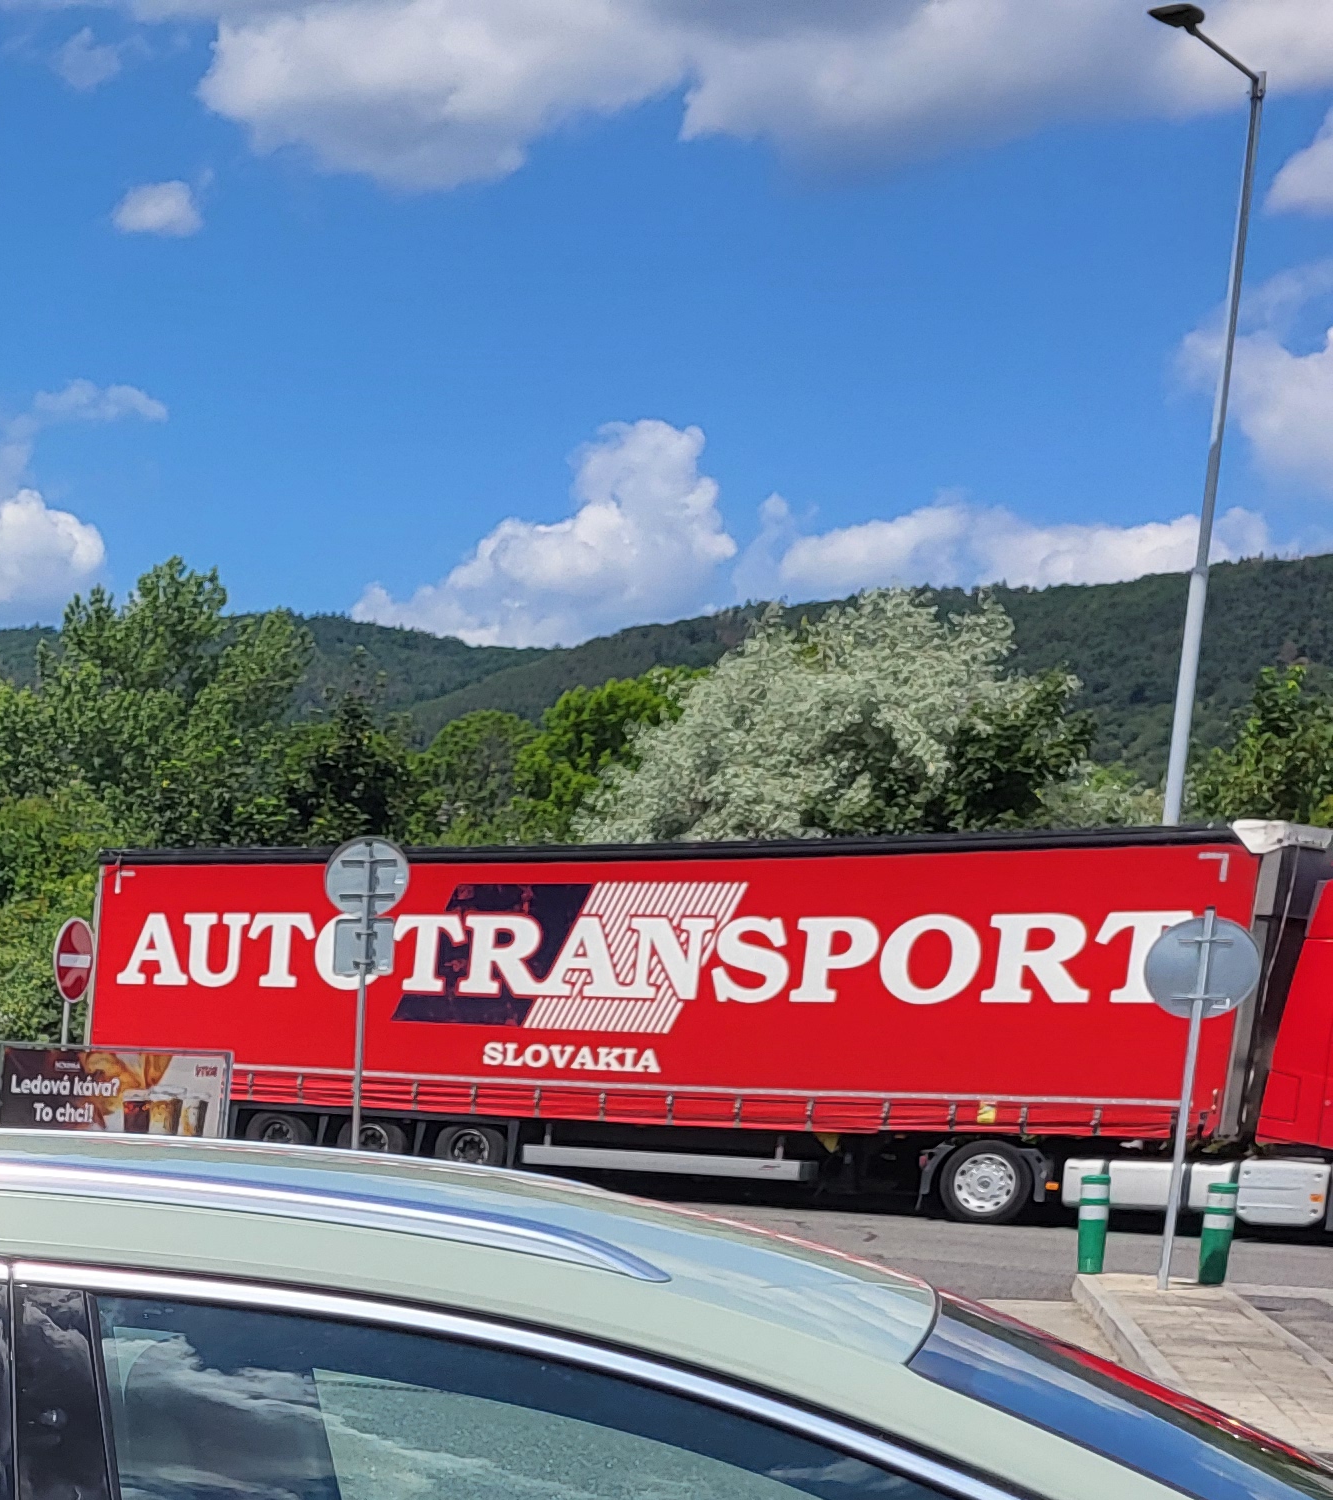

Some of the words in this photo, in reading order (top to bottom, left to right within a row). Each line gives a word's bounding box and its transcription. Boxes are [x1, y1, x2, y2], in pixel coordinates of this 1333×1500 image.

[482, 1041, 662, 1073] SLOVAKIA
[10, 1073, 71, 1096] Ledová
[73, 1074, 121, 1098] káva?
[33, 1101, 54, 1122] To
